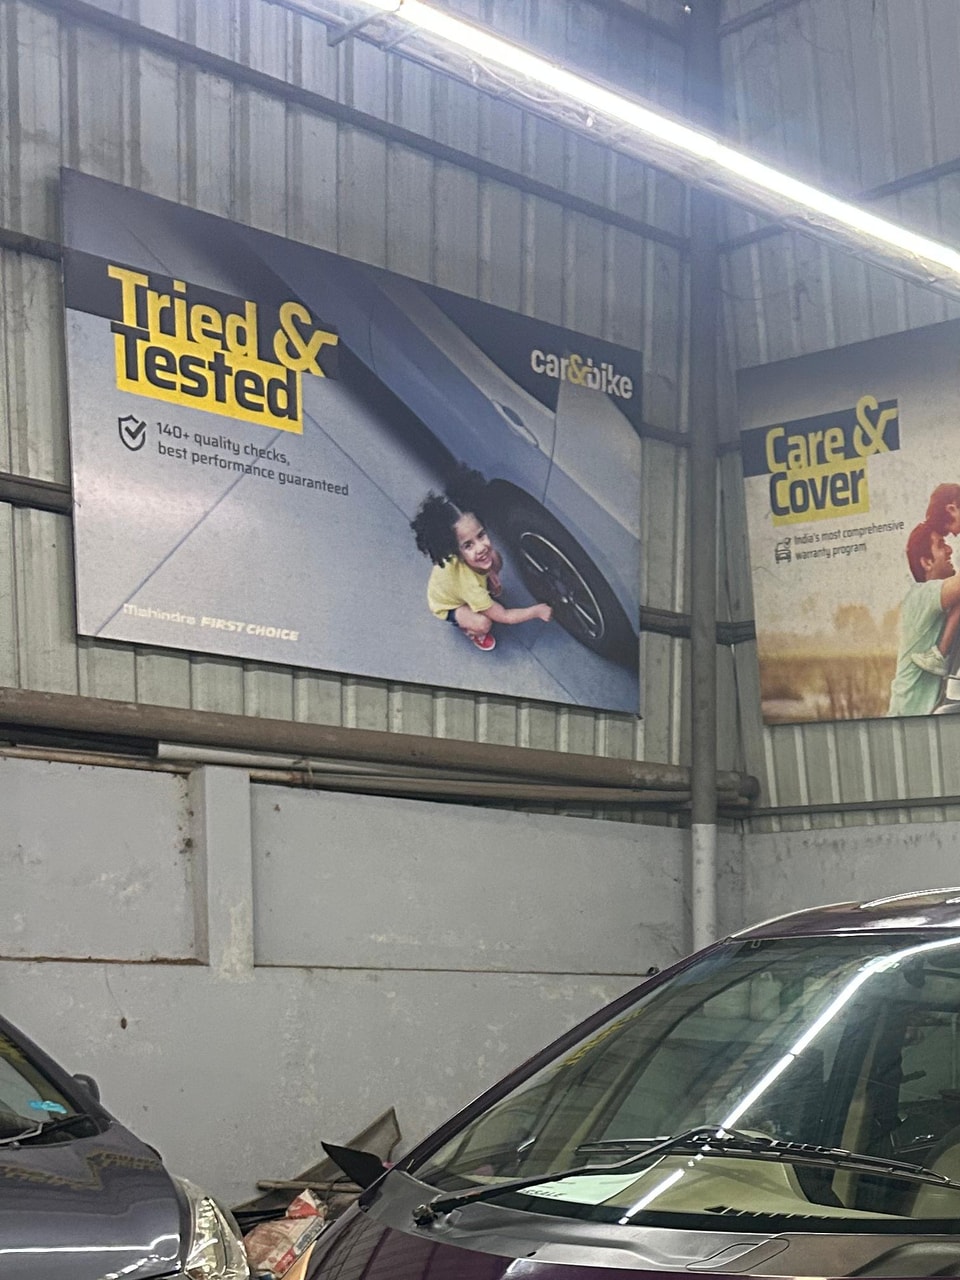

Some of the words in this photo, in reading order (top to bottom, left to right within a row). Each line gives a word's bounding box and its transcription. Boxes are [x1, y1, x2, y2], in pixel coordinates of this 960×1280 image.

[107, 264, 257, 358] Tried
[274, 302, 338, 376] &
[110, 322, 299, 420] Tested
[531, 349, 633, 399] car&bike
[156, 422, 190, 440] 140+
[194, 433, 240, 455] quality
[244, 444, 290, 466] checks,
[766, 426, 844, 473] Care
[853, 395, 899, 457] &
[158, 441, 188, 460] best
[192, 451, 275, 480] performance
[278, 472, 349, 496] guaranteed
[769, 467, 865, 517] Cover
[794, 532, 820, 545] India's
[821, 530, 842, 541] most
[842, 521, 905, 538] comprehensive
[795, 547, 832, 560] warranty
[833, 543, 867, 557] program
[123, 603, 196, 625] Mahindra
[200, 616, 245, 632] FIRST
[246, 623, 300, 641] CHOICE
